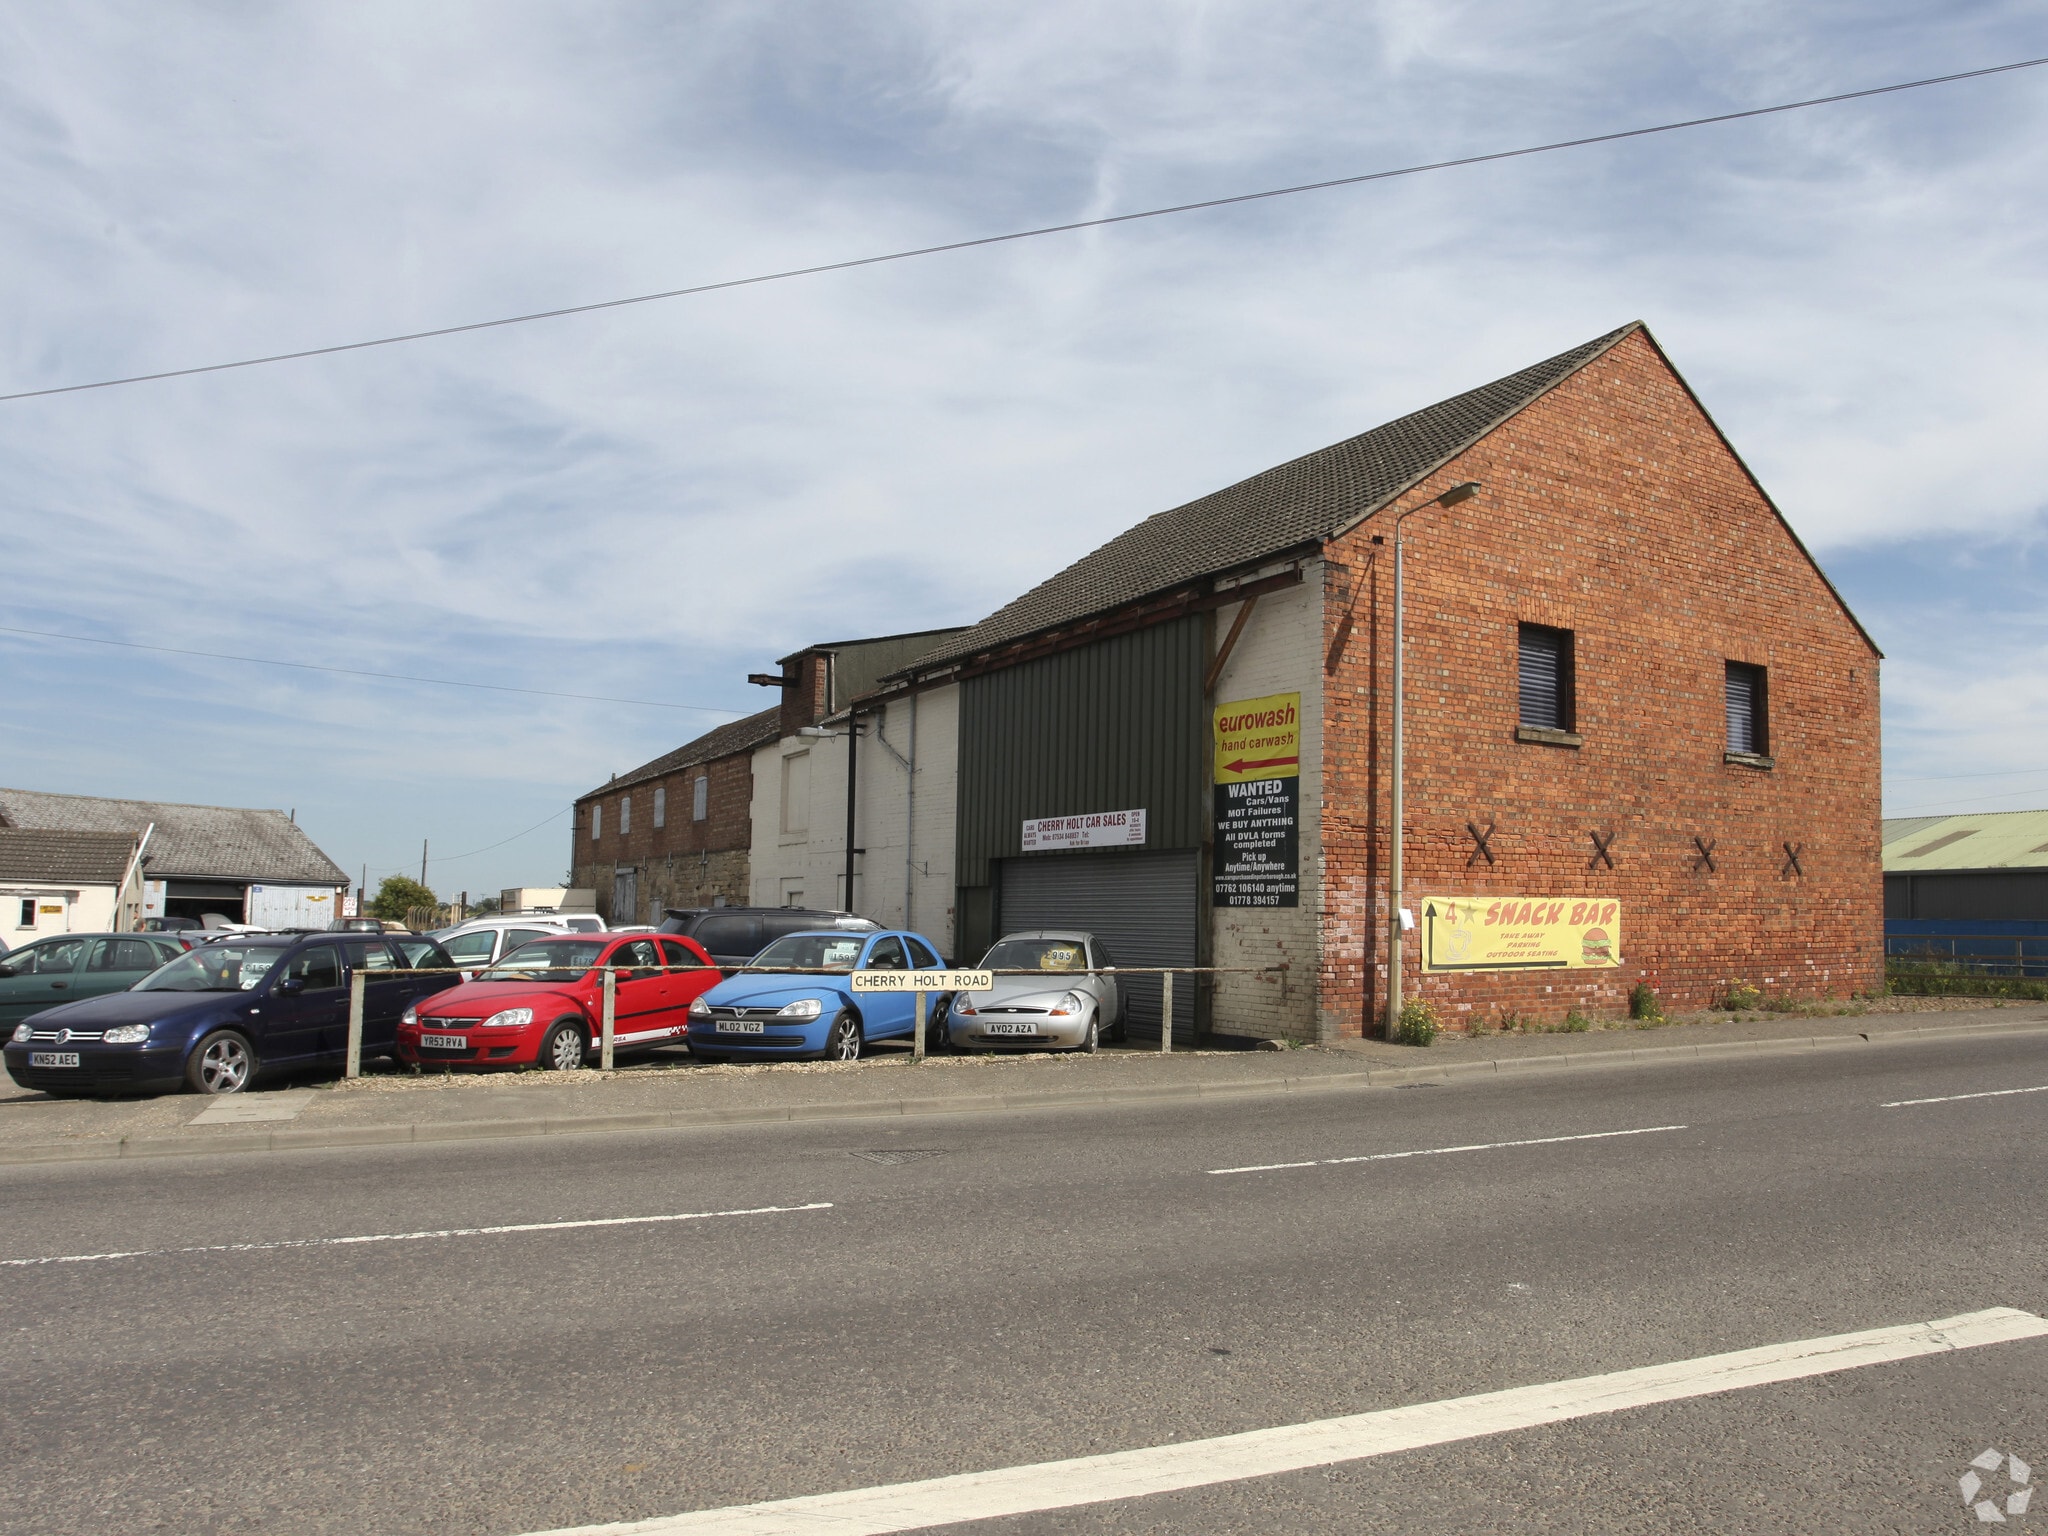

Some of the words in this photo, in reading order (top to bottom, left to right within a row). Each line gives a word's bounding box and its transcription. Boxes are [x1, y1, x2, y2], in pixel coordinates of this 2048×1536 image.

[1219, 702, 1295, 733] eurowash
[1221, 737, 1246, 752] hand
[1249, 731, 1294, 749] carwash
[1228, 780, 1282, 798] WANTED
[1246, 795, 1290, 806] Cars/Vans
[1228, 808, 1246, 817] MOT
[1248, 807, 1282, 816] Failures
[1038, 820, 1065, 832] CHERRY
[1066, 817, 1085, 830] HOLT
[1085, 815, 1101, 828] CAR
[1103, 813, 1127, 827] SALES
[1218, 821, 1231, 830] WE
[1232, 820, 1249, 829] BUY
[1250, 817, 1294, 828] ANYTHING
[1225, 833, 1236, 841] All
[1238, 831, 1259, 840] DVLA
[1261, 831, 1286, 839] forms
[1233, 839, 1276, 850] completed
[1242, 852, 1257, 862] Pick
[1258, 853, 1267, 863] up
[1225, 861, 1285, 874] Anytime/Anywhere
[1215, 883, 1237, 893] 07762
[1239, 883, 1265, 893] 106140
[1266, 882, 1296, 894] anytime
[1229, 896, 1251, 905] 01778
[1253, 896, 1280, 905] 394157
[1445, 901, 1458, 925] 4
[1484, 902, 1565, 926] SNACK
[1568, 902, 1617, 926] BAR
[855, 975, 906, 987] CHERRY
[914, 975, 947, 986] HOLT
[954, 975, 989, 986] ROAD
[743, 1023, 760, 1032] VGZ
[991, 1024, 1013, 1033] AY02
[1015, 1024, 1033, 1033] AZA
[424, 1036, 445, 1047] YR53
[445, 1037, 463, 1047] RVA
[33, 1054, 57, 1065] KN52
[58, 1054, 77, 1065] AEC
